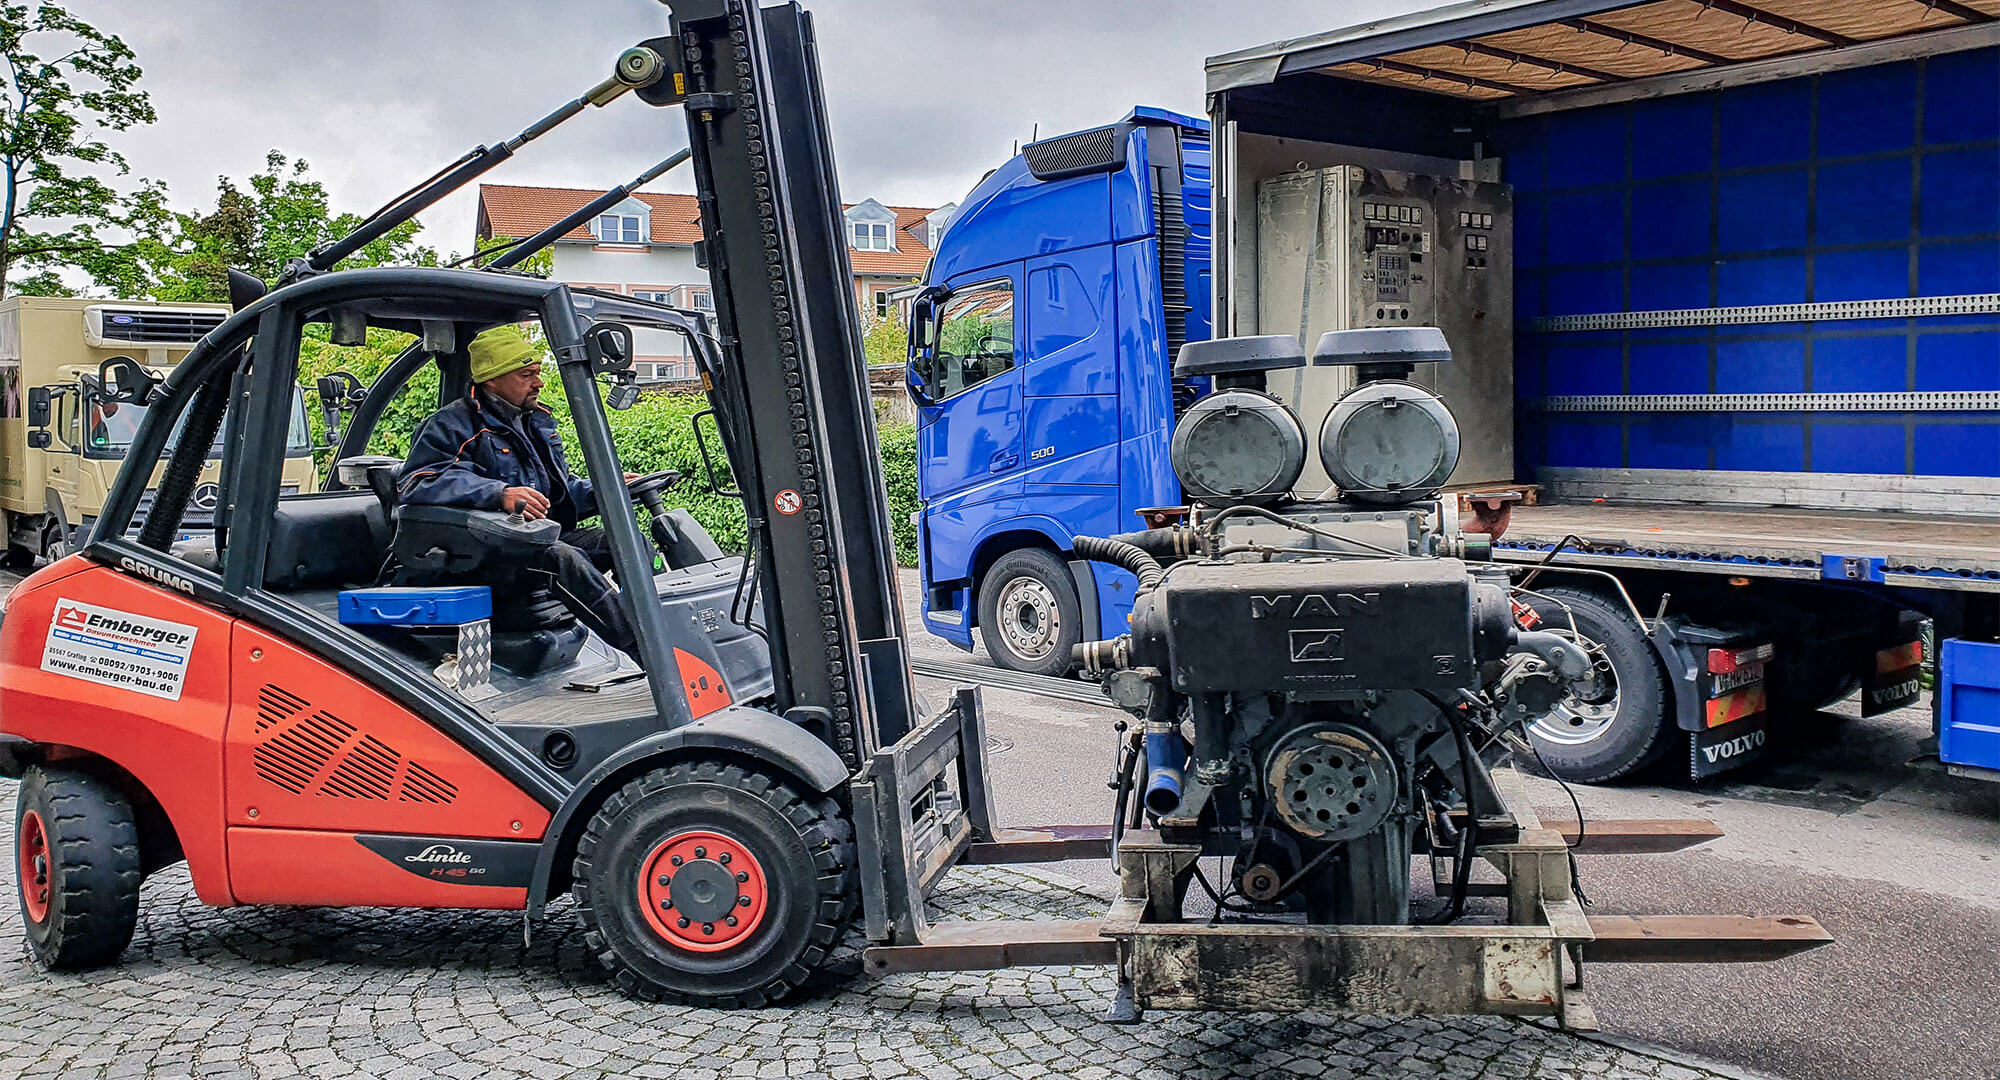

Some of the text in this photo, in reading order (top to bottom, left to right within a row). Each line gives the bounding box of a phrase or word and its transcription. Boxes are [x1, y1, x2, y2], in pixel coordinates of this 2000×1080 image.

[1031, 446, 1055, 460] 500
[120, 557, 195, 595] GRUMA
[1250, 592, 1380, 618] MAN
[86, 628, 157, 648] Bauunternehmen
[87, 614, 190, 645] Emberger
[49, 658, 174, 693] www.emberger-bau.de
[1872, 679, 1919, 705] VOLVO
[1702, 729, 1766, 763] VOLVO
[404, 844, 472, 864] Linde
